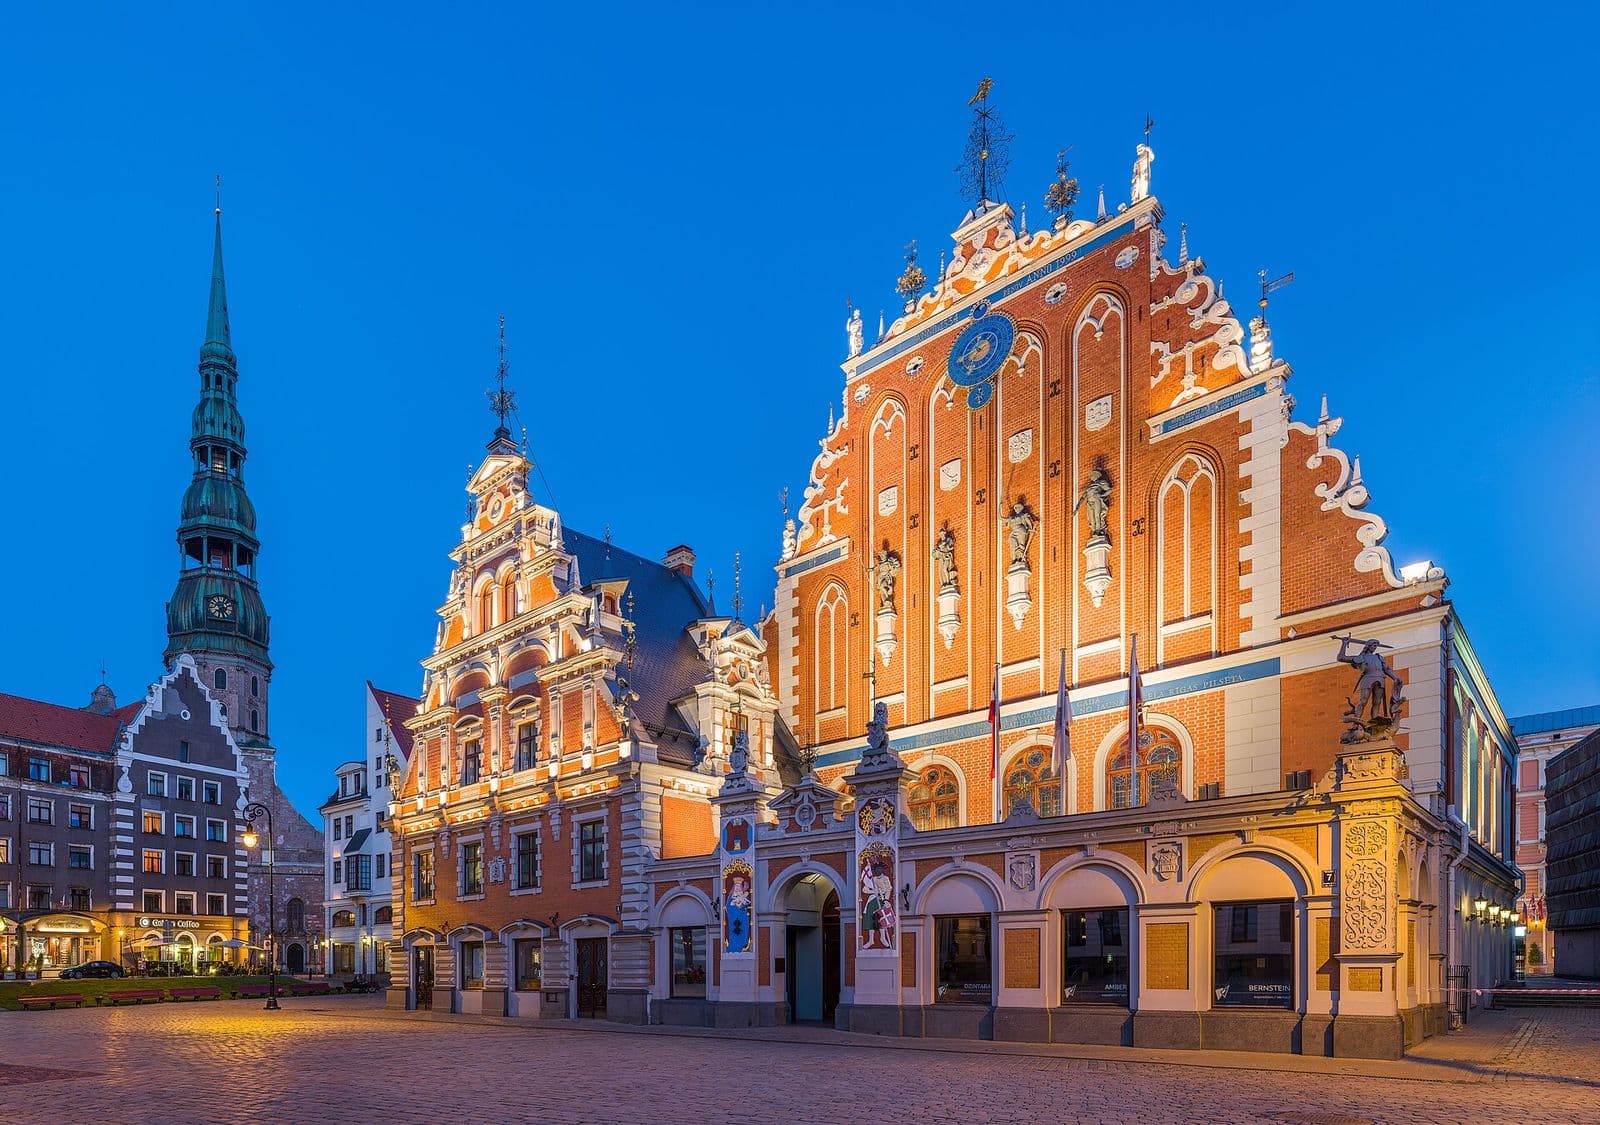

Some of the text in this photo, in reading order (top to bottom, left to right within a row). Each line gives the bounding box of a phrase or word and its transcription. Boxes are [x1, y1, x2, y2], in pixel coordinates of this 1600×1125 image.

[1028, 264, 1052, 282] ANNO
[1055, 250, 1078, 270] 1999
[1248, 984, 1291, 992] BERNSTEIN
